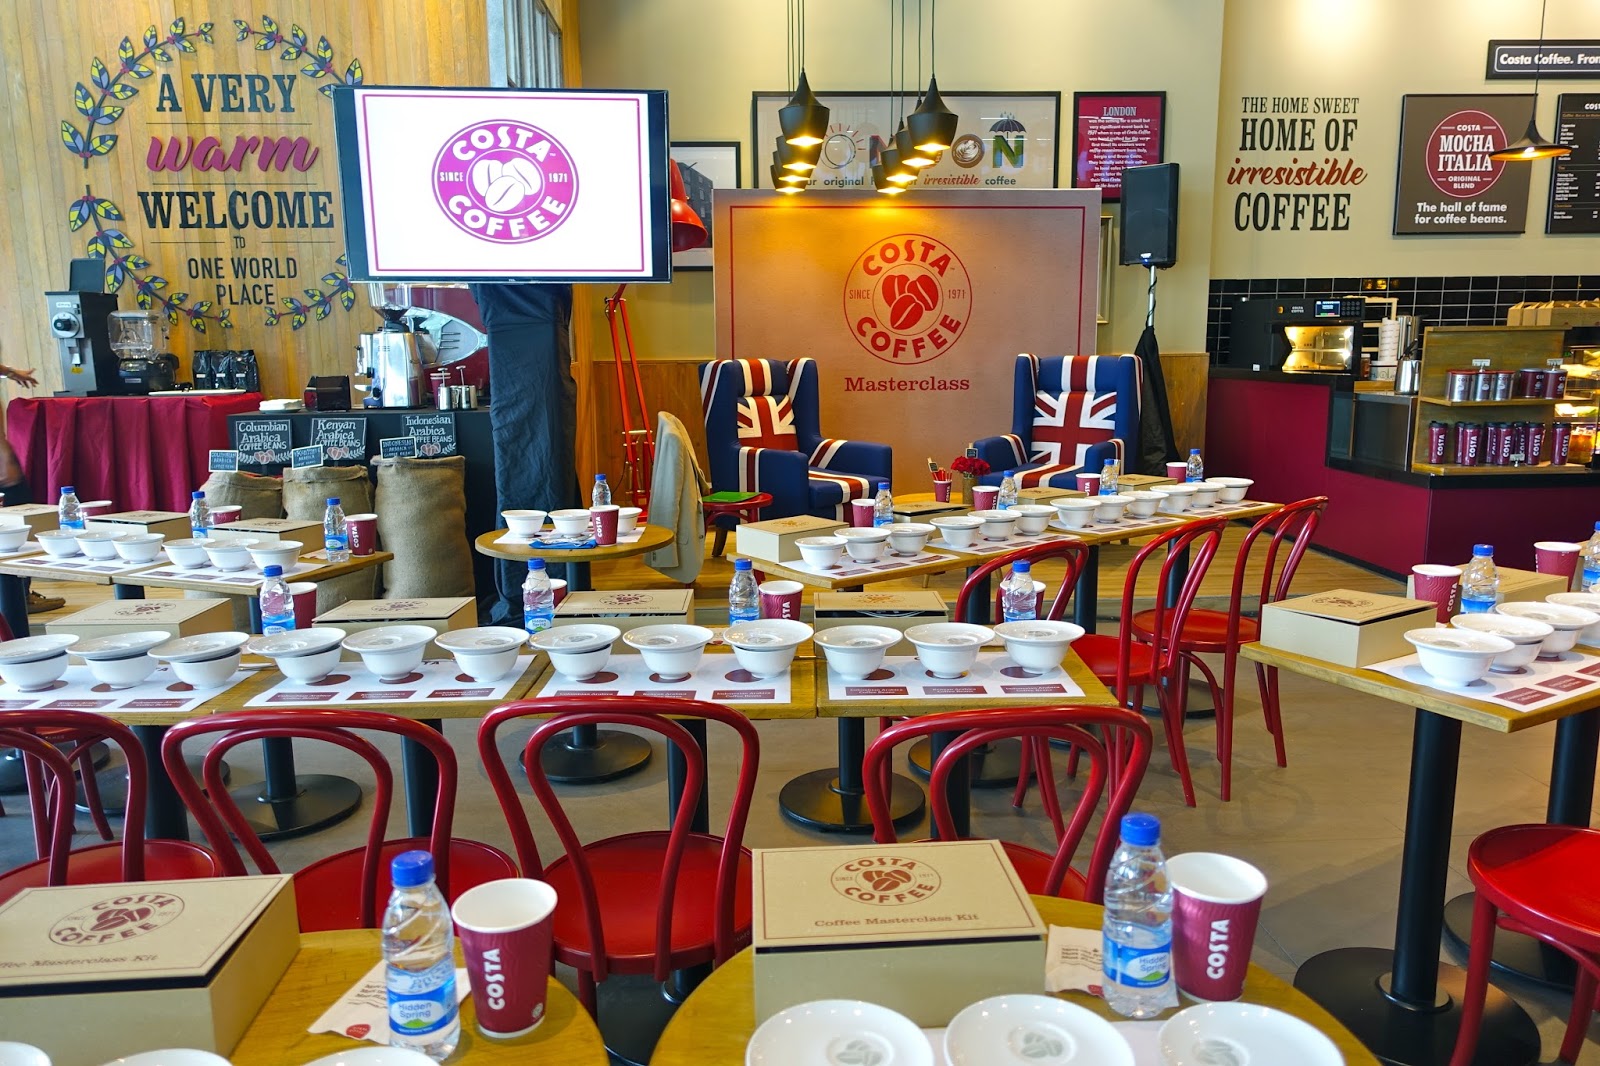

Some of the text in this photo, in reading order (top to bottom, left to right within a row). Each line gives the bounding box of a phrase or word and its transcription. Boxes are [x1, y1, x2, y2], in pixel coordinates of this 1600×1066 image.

[1500, 53, 1532, 64] Costa
[1534, 53, 1574, 64] Coffee.
[156, 73, 297, 113] A VERY
[1103, 106, 1137, 116] LONDON
[1242, 96, 1360, 114] THE HOME SWEET
[1239, 117, 1358, 151] HOME OF
[1439, 134, 1495, 152] MOCHA
[452, 126, 552, 163] COSTA
[146, 136, 319, 172] warm
[1437, 153, 1493, 172] ITALIA
[440, 172, 568, 183] SINCE 1971
[1226, 157, 1368, 186] irresistible
[823, 176, 864, 187] original
[923, 175, 980, 186] irresistible
[985, 176, 1017, 186] coffee
[138, 190, 335, 229] WELCOME
[1234, 192, 1351, 231] COFFEE
[1417, 202, 1508, 212] The hall of fame
[449, 195, 566, 238] COFFEE
[1414, 213, 1507, 224] for coffee beans.
[233, 236, 246, 249] TO
[862, 239, 951, 278] COSTA
[188, 257, 298, 279] ONE WORLD
[216, 285, 276, 306] PLACE
[849, 289, 966, 300] SINCE 1971
[857, 314, 962, 359] COFFEE
[844, 376, 970, 392] Masterclass
[238, 421, 288, 432] Columbian
[317, 420, 356, 431] Kenyan
[405, 415, 452, 425] Indonesian
[241, 432, 281, 443] Arabica
[316, 430, 355, 440] Arabica
[409, 426, 446, 436] Arabica
[431, 435, 453, 443] BEANS
[239, 441, 287, 451] COFFEE BEANS
[1437, 434, 1445, 456] COSTA
[1468, 435, 1478, 458] COSTA
[1503, 435, 1512, 457] COSTA
[1533, 434, 1541, 456] COSTA
[1561, 434, 1569, 457] COSTA
[595, 516, 603, 538] COSTA
[351, 526, 360, 548] COSTA
[1447, 582, 1458, 612] COSTA
[782, 601, 792, 619] STA
[844, 858, 917, 872] COSTA
[844, 883, 935, 903] COFFEE
[92, 895, 176, 911] COSTA
[815, 913, 979, 927] Coffee Masterclass Kit
[55, 922, 158, 944] COFFEE
[1206, 919, 1230, 979] COSTA
[482, 948, 506, 1010] COSTA
[399, 1002, 432, 1010] Hidden
[399, 1010, 432, 1019] Spring
